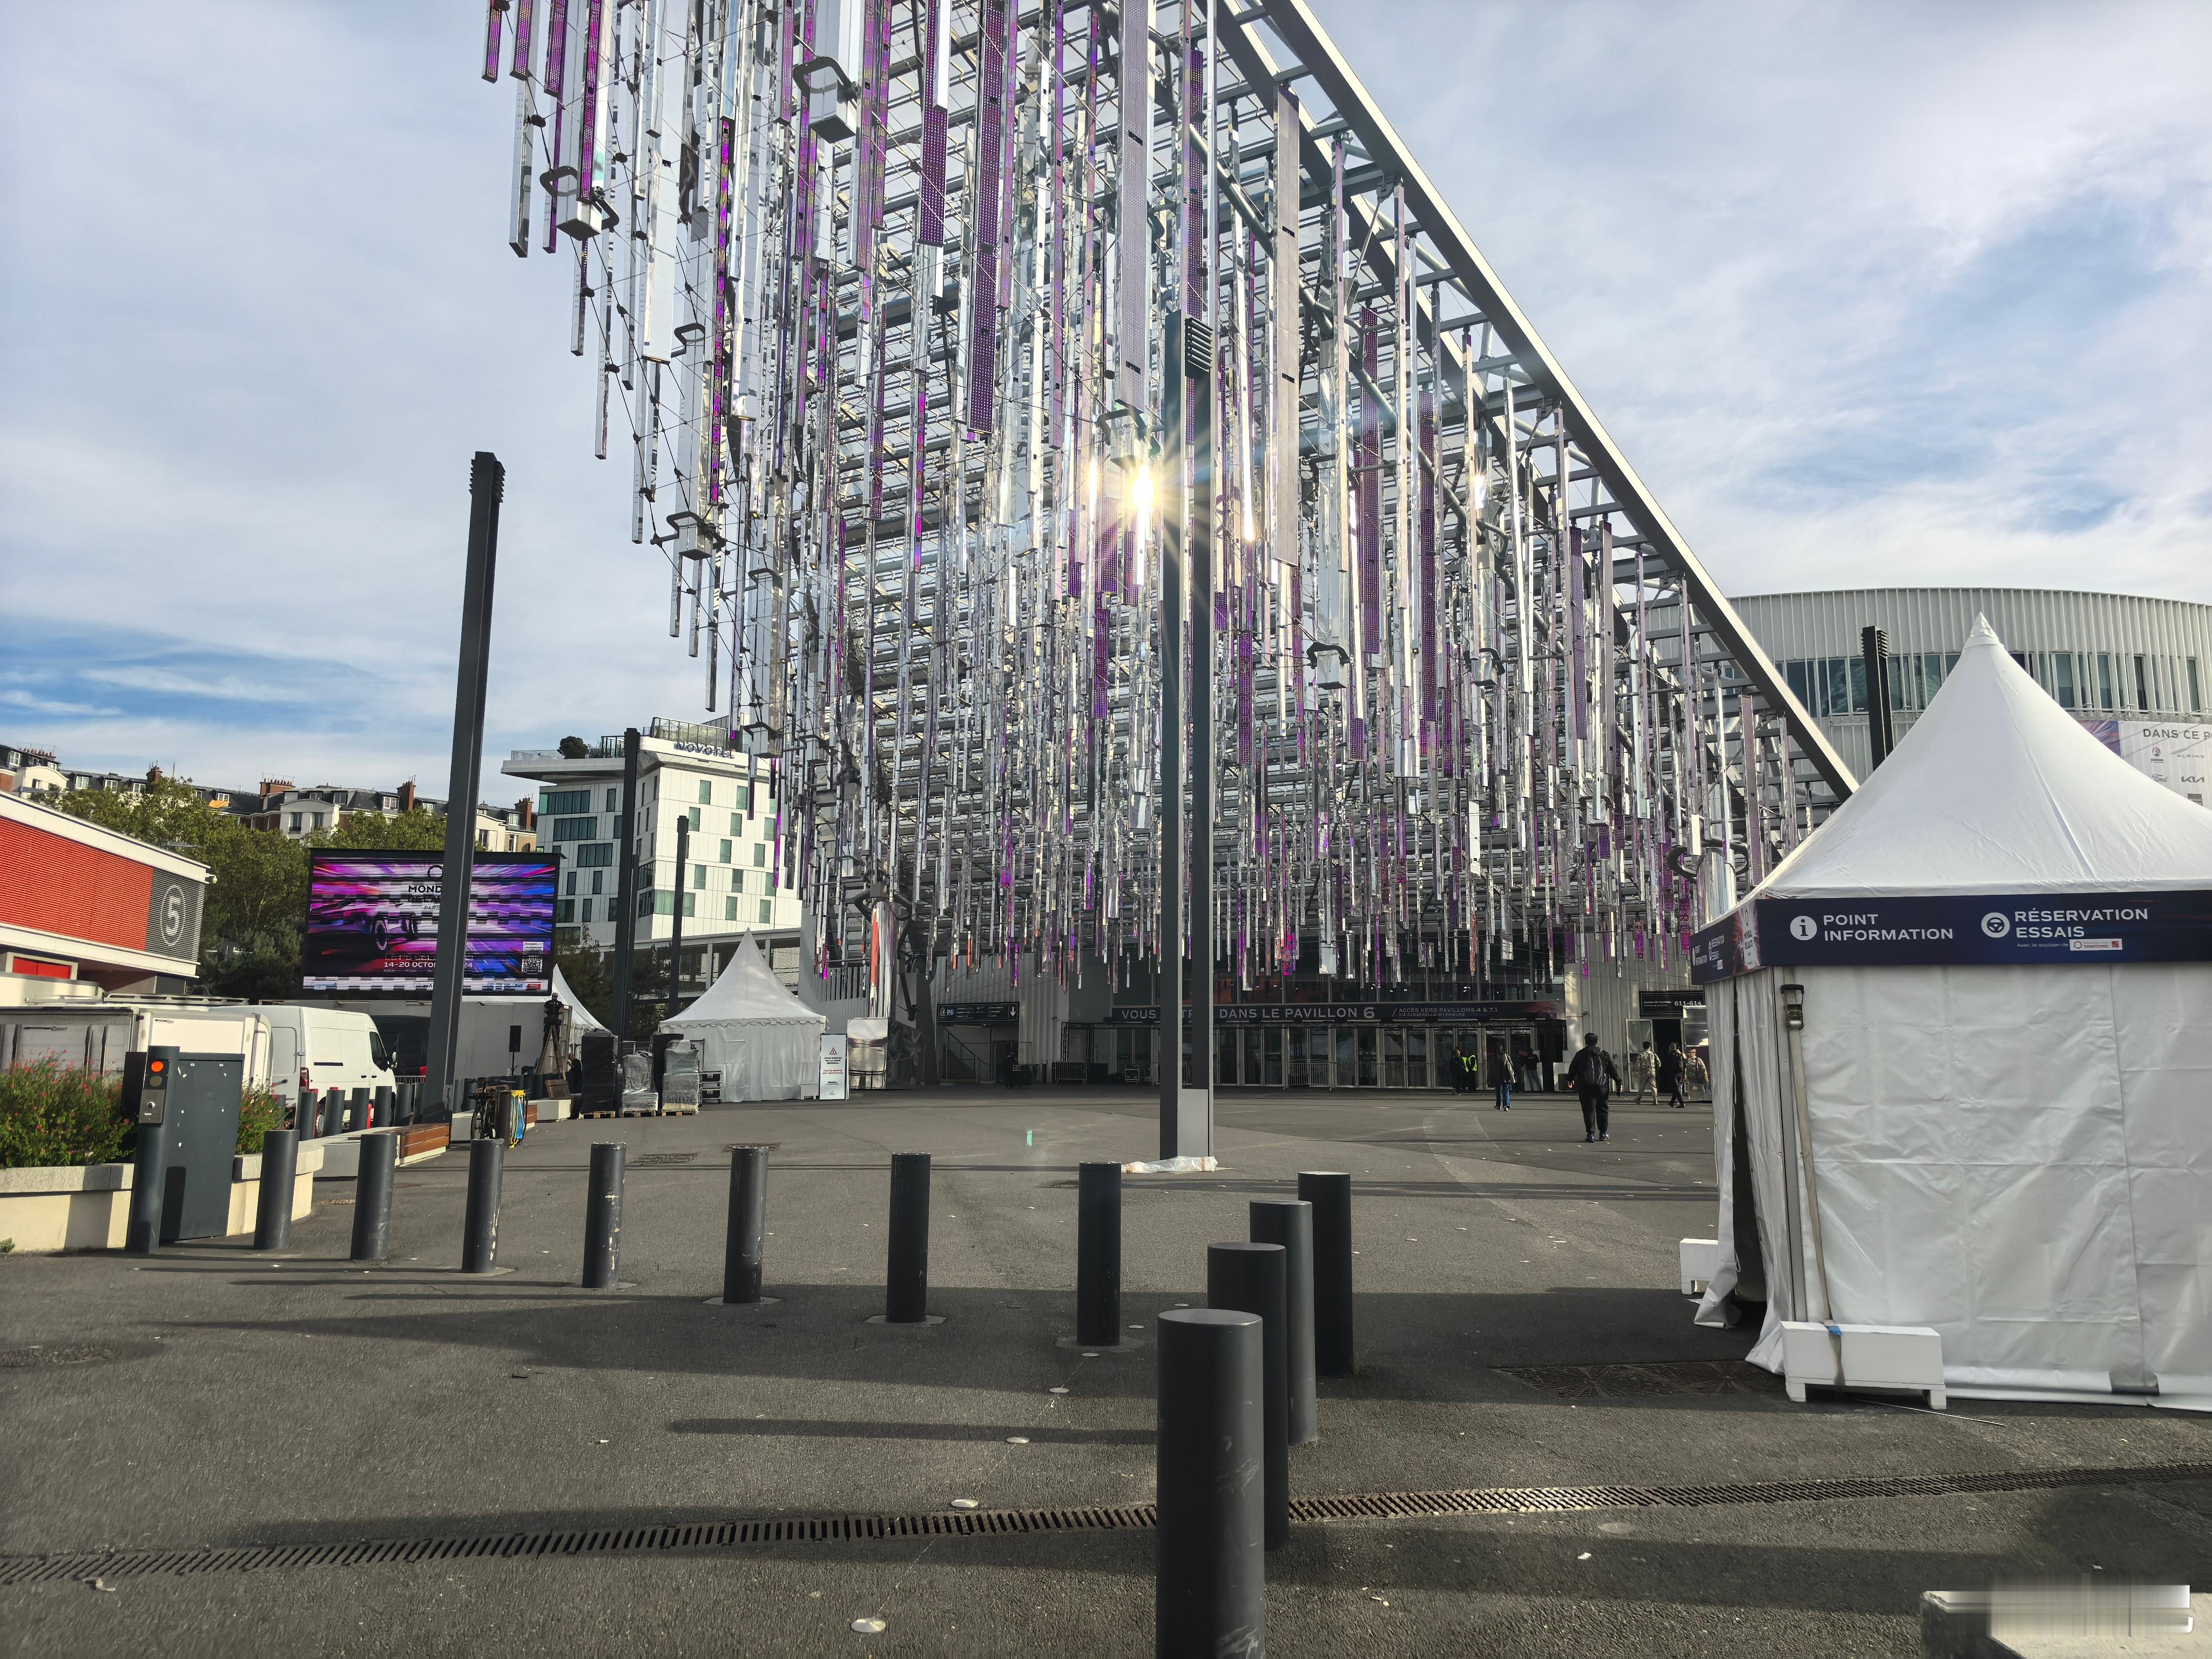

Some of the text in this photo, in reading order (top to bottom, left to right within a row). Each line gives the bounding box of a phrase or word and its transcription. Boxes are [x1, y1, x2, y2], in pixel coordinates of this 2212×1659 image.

[2143, 729, 2212, 740] DANS CE P
[675, 743, 734, 759] NOVOTEL
[408, 885, 441, 893] MOND
[165, 896, 181, 936] 5
[1823, 914, 1878, 926] POINT
[2014, 908, 2148, 922] RÉSERVATION
[1824, 928, 1953, 941] INFORMATION
[2016, 926, 2085, 938] ESSAIS
[1122, 1009, 1157, 1019] VOUS
[1219, 1007, 1375, 1019] DANS LE PAVILLON 6
